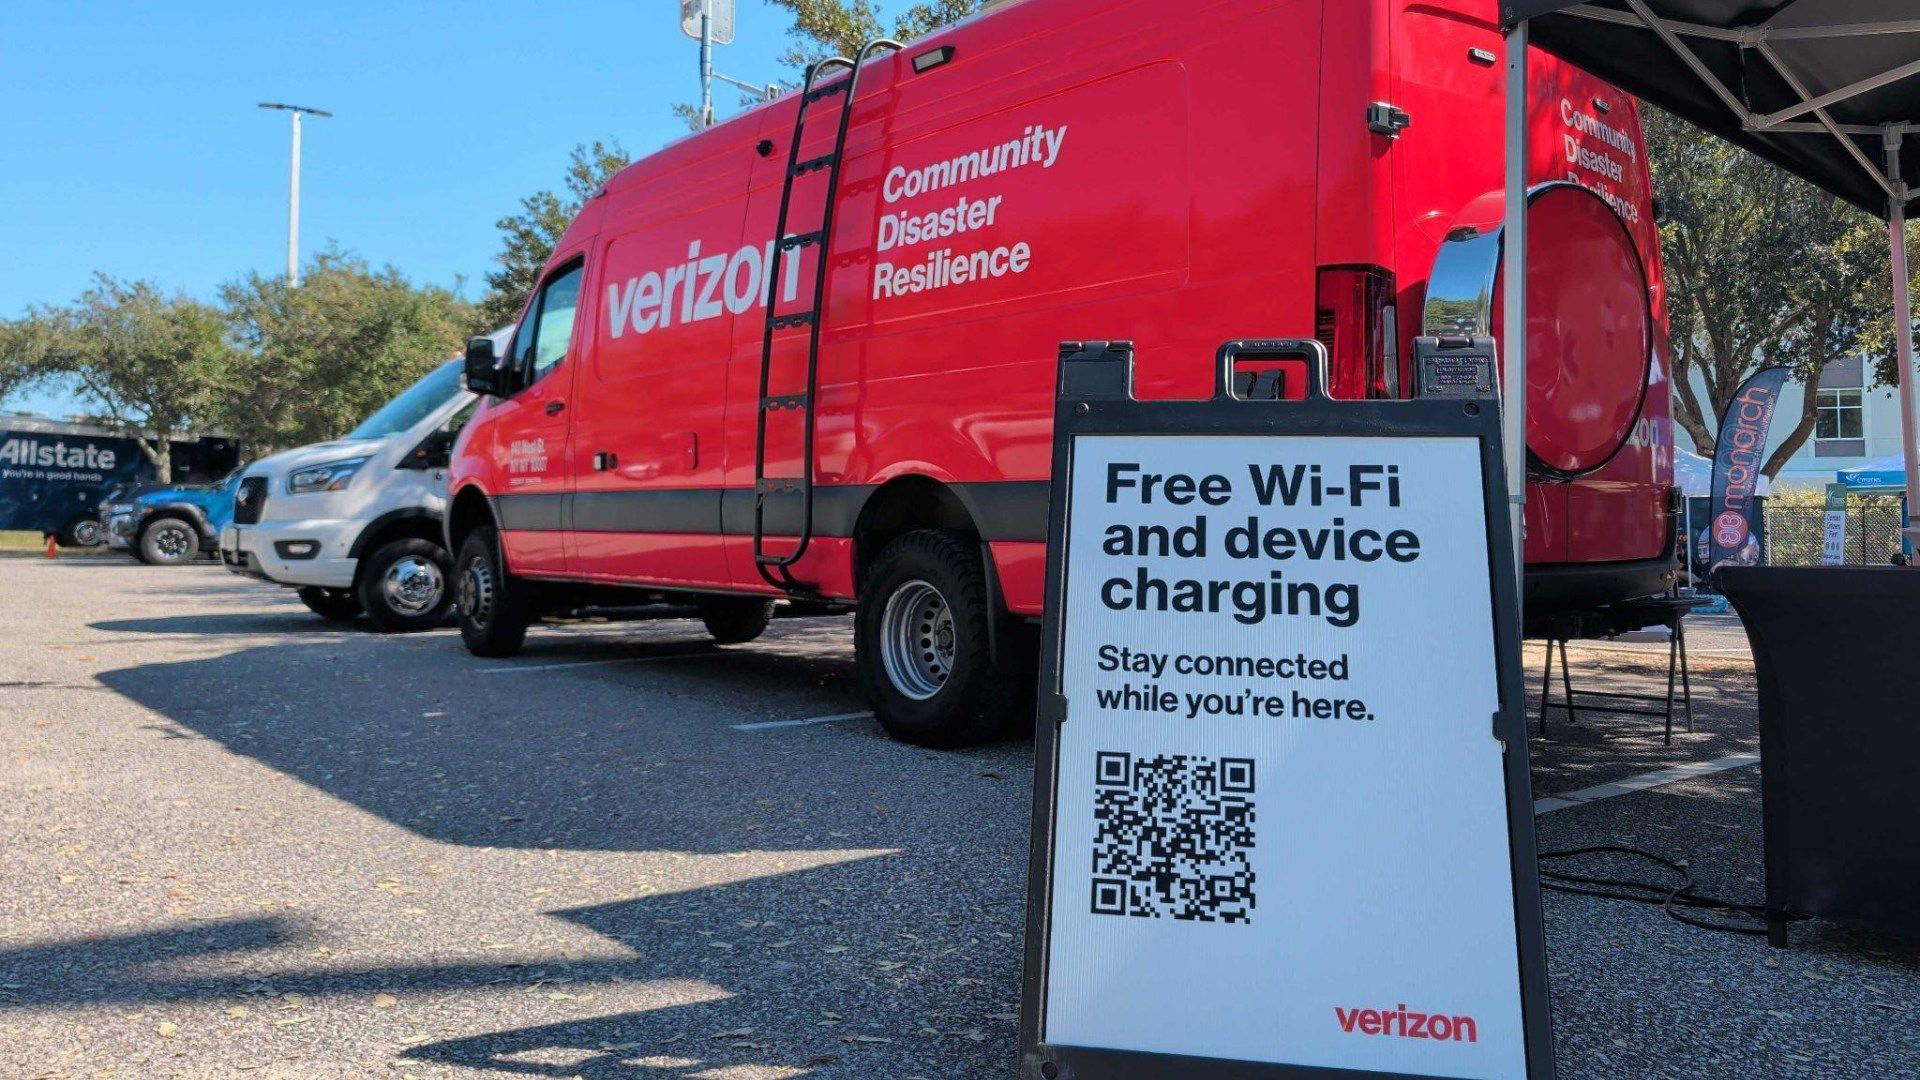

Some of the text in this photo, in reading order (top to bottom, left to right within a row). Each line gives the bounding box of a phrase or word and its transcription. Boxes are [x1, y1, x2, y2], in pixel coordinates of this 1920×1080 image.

[1560, 98, 1636, 164] Community
[883, 125, 1067, 203] Community
[1564, 133, 1623, 183] Disaster
[1567, 171, 1638, 223] lience
[877, 194, 1002, 253] Disaster
[608, 234, 802, 339] verizon
[872, 240, 1031, 300] Resilience
[0, 438, 116, 470] Allstate
[1725, 387, 1769, 509] monarch
[46, 471, 72, 481] good
[1106, 462, 1401, 507] Free Wi-Fi
[1103, 515, 1421, 562] and device
[1101, 566, 1360, 627] charging
[1097, 644, 1349, 681] Stay connected
[1096, 684, 1375, 721] while you're here.
[1334, 1003, 1478, 1042] verizon
